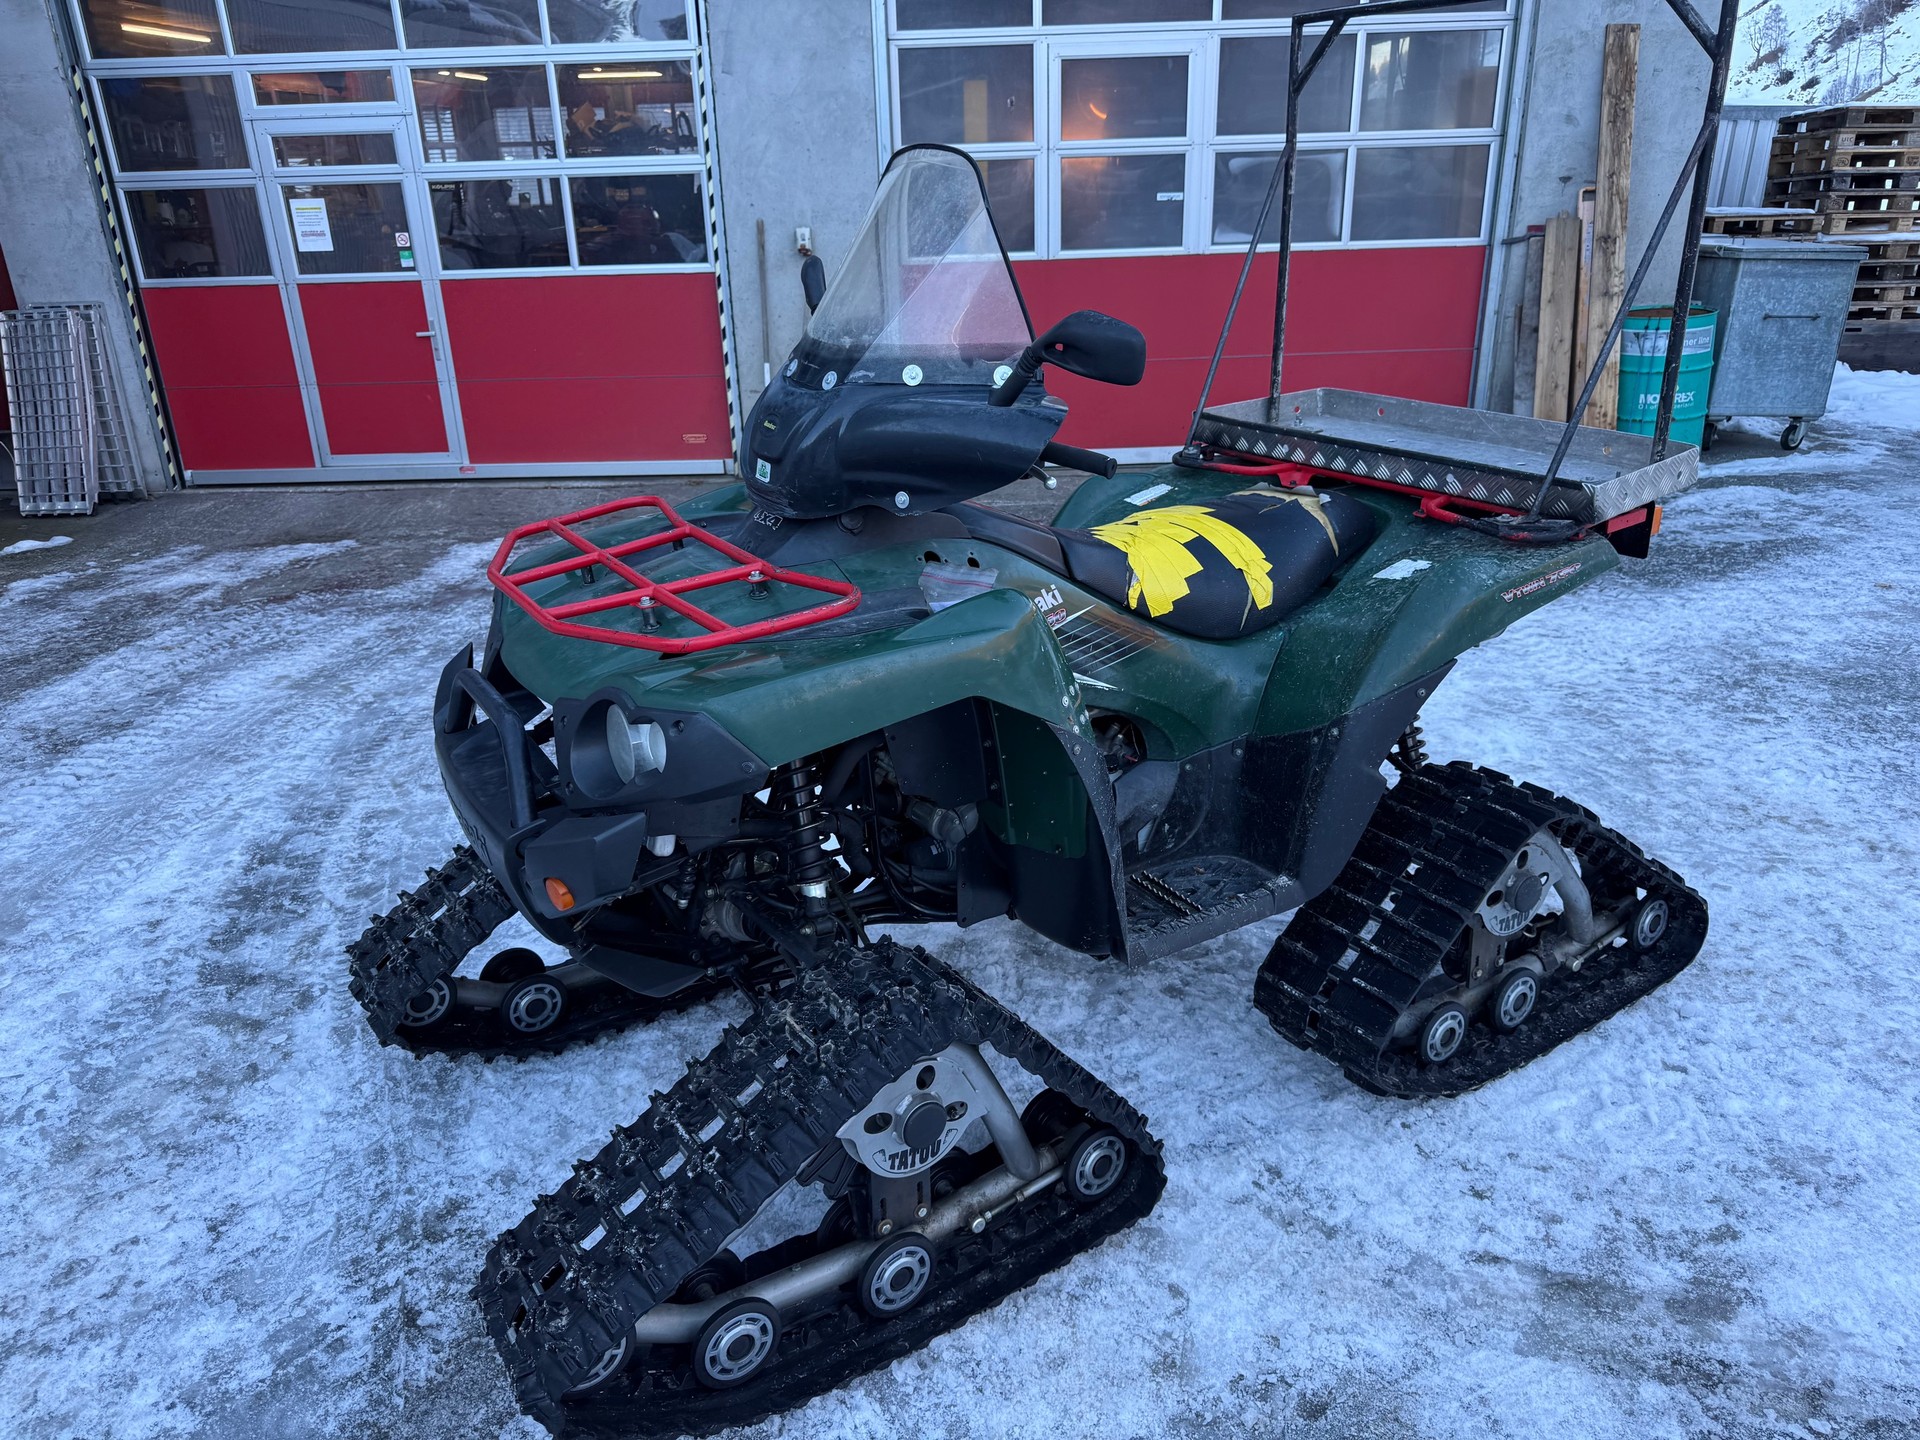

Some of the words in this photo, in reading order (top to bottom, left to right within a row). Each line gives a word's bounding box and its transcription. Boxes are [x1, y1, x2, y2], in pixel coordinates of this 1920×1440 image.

[1638, 391, 1696, 405] MOREX
[1034, 584, 1064, 612] aki
[1045, 608, 1067, 627] 50
[888, 1138, 942, 1171] TATOU
